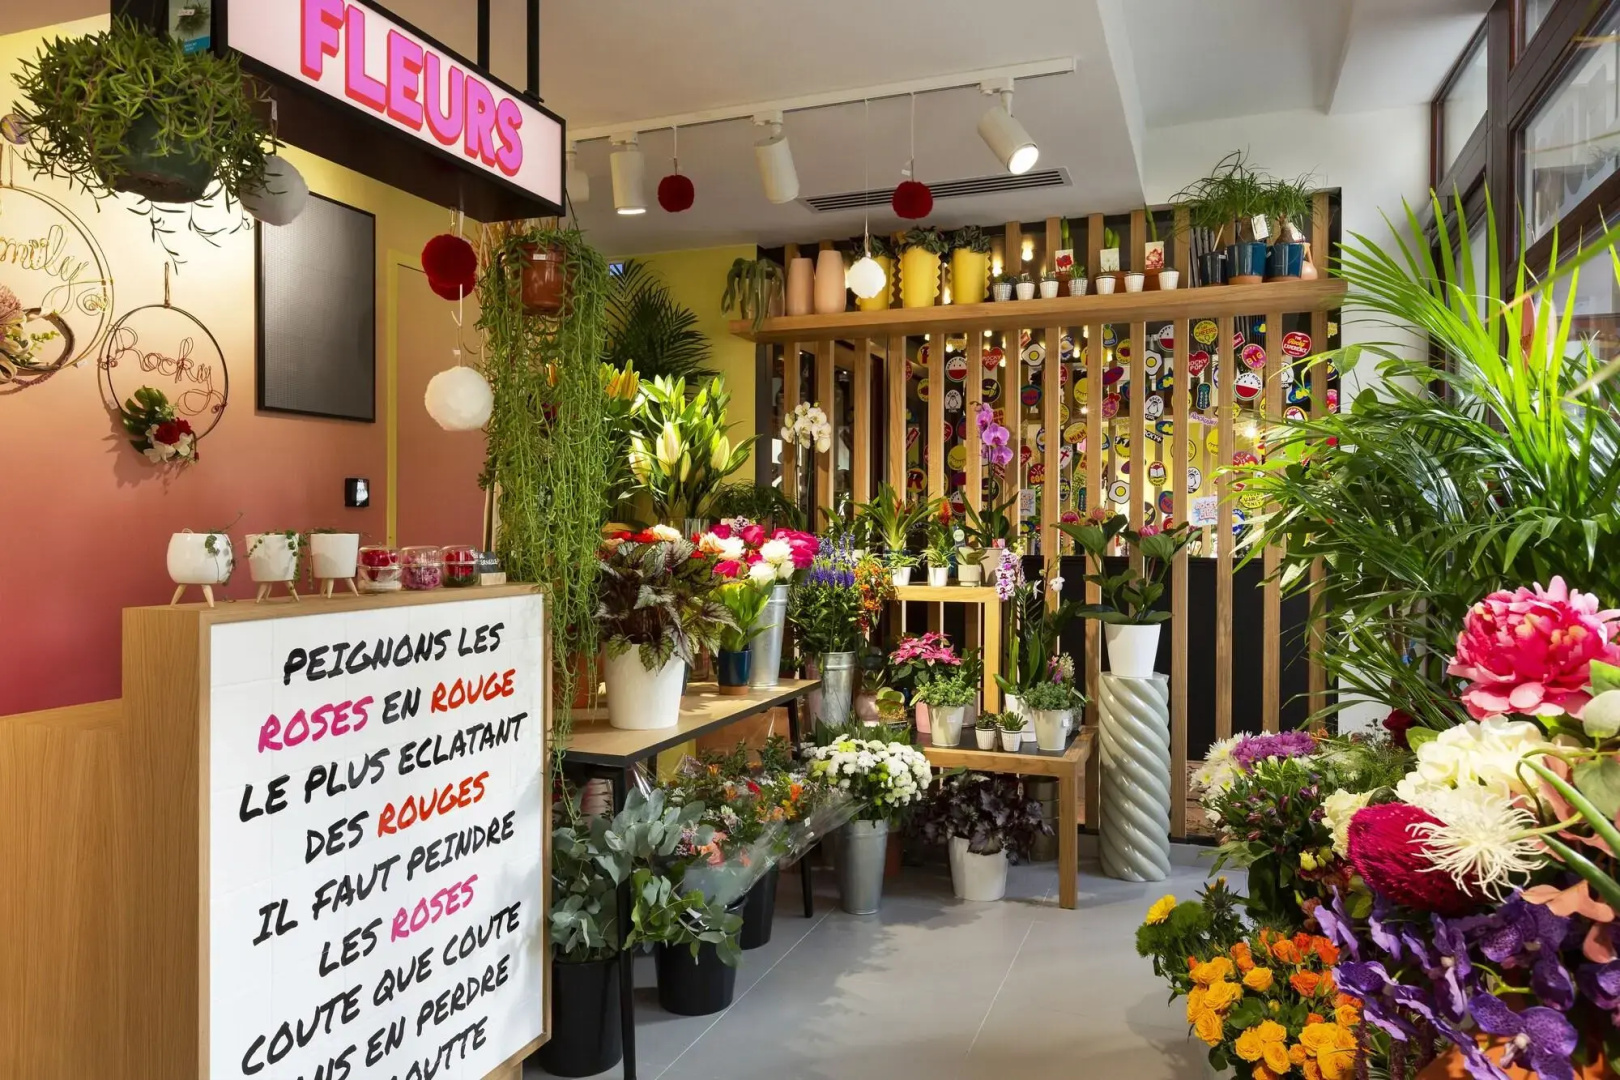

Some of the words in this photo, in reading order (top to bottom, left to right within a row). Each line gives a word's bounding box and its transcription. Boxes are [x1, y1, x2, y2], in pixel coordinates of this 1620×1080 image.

[300, 0, 523, 176] FLEURS
[1236, 374, 1250, 383] HAPPY
[1252, 375, 1261, 389] ROCKY
[1246, 352, 1263, 365] BIG
[1030, 473, 1045, 483] GOO
[283, 629, 451, 686] PEIGNONS
[458, 622, 505, 657] LES
[257, 695, 374, 753] ROSES
[382, 686, 421, 725] EN
[431, 668, 516, 713] ROUGE
[239, 774, 290, 823] LE
[304, 748, 391, 804] PLUS
[397, 711, 528, 776] ECLATANT
[305, 810, 369, 864] DES
[377, 770, 490, 838] ROUGES
[252, 898, 298, 947] IL
[312, 854, 401, 920] FAUT
[406, 809, 516, 882] PEINDRE
[318, 917, 383, 978] LES
[390, 874, 478, 943] ROSES
[241, 984, 363, 1076] COUTE
[372, 946, 434, 1007] QUE
[442, 901, 521, 966] COUTE
[365, 1016, 406, 1068] EN
[416, 954, 511, 1036] PERDRE
[390, 1016, 488, 1080] OUTTE
